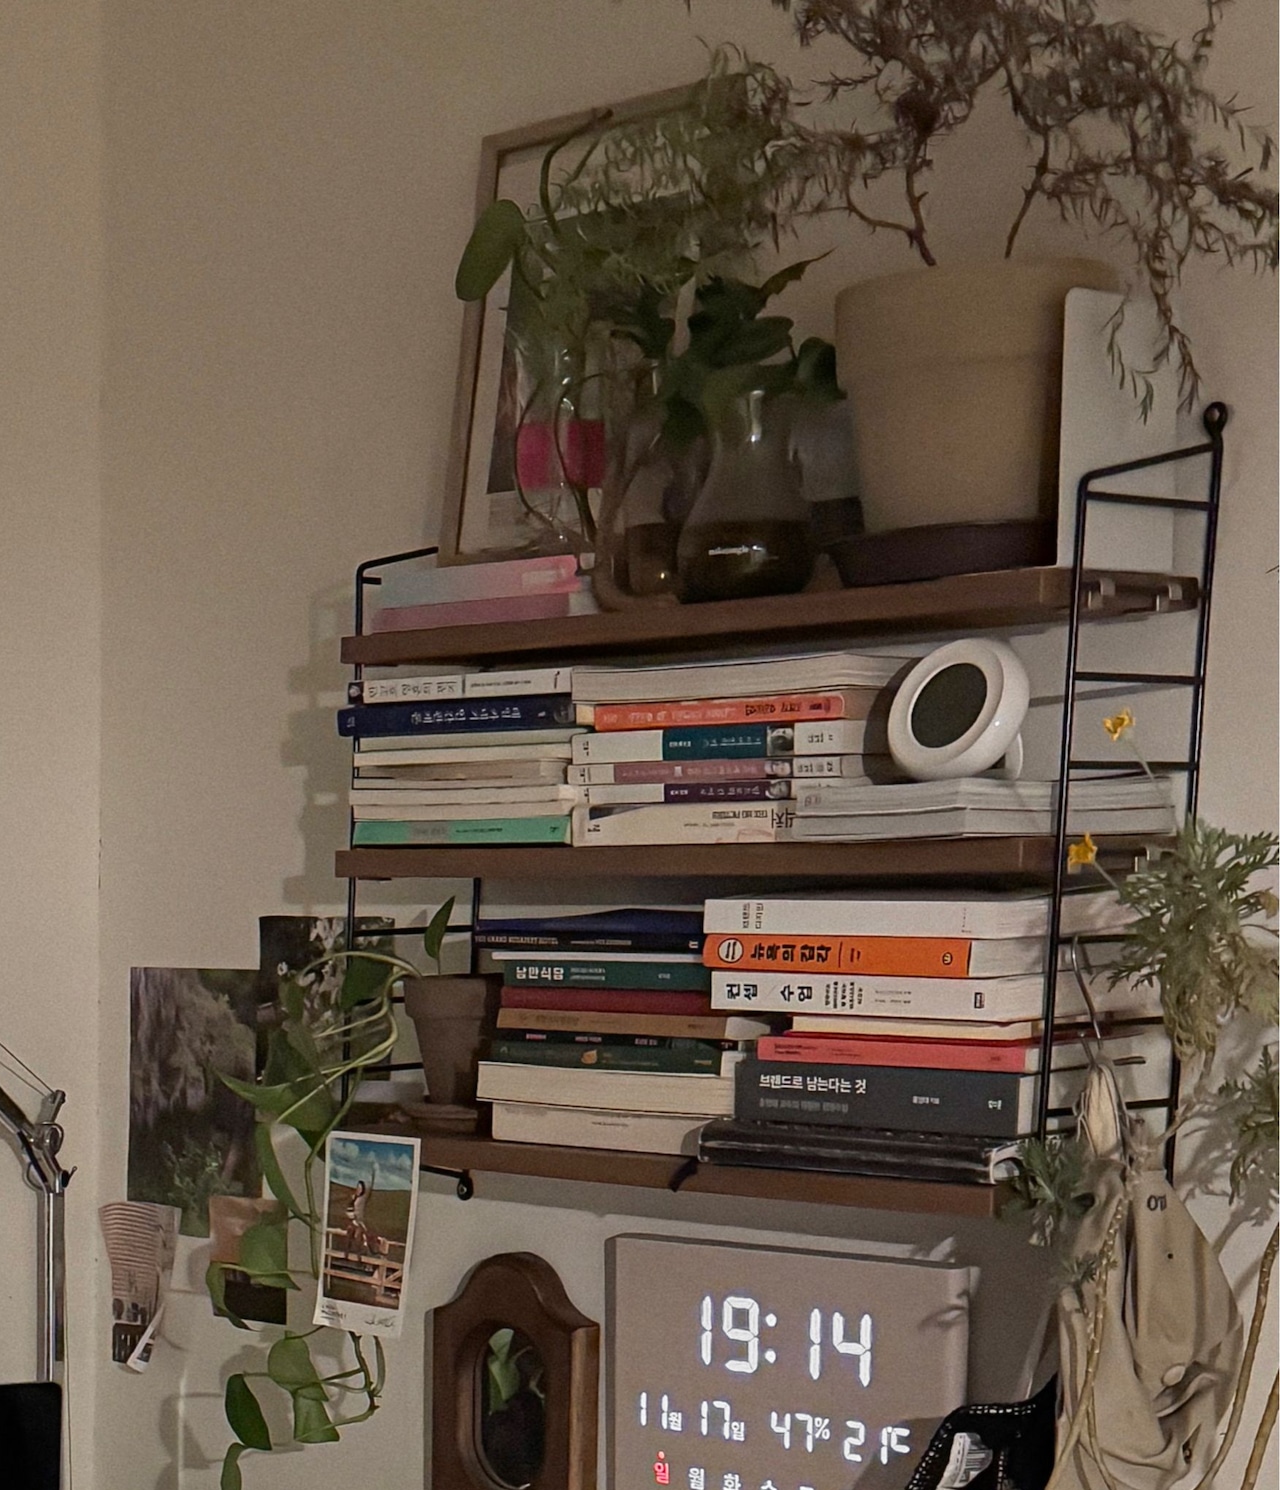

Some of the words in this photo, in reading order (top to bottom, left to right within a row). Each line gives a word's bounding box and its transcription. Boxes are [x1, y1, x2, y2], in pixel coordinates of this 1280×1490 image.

[750, 942, 796, 962] 뉴욕의
[800, 944, 832, 963] 감각
[726, 983, 758, 1000] 컨셉
[780, 984, 813, 1002] 수업
[759, 1074, 803, 1090] 브랜드로
[806, 1076, 852, 1093] 남는다는
[855, 1078, 867, 1094] 것
[700, 1295, 872, 1387] 19:14
[771, 1411, 831, 1453] 47%
[653, 1462, 670, 1485] 일
